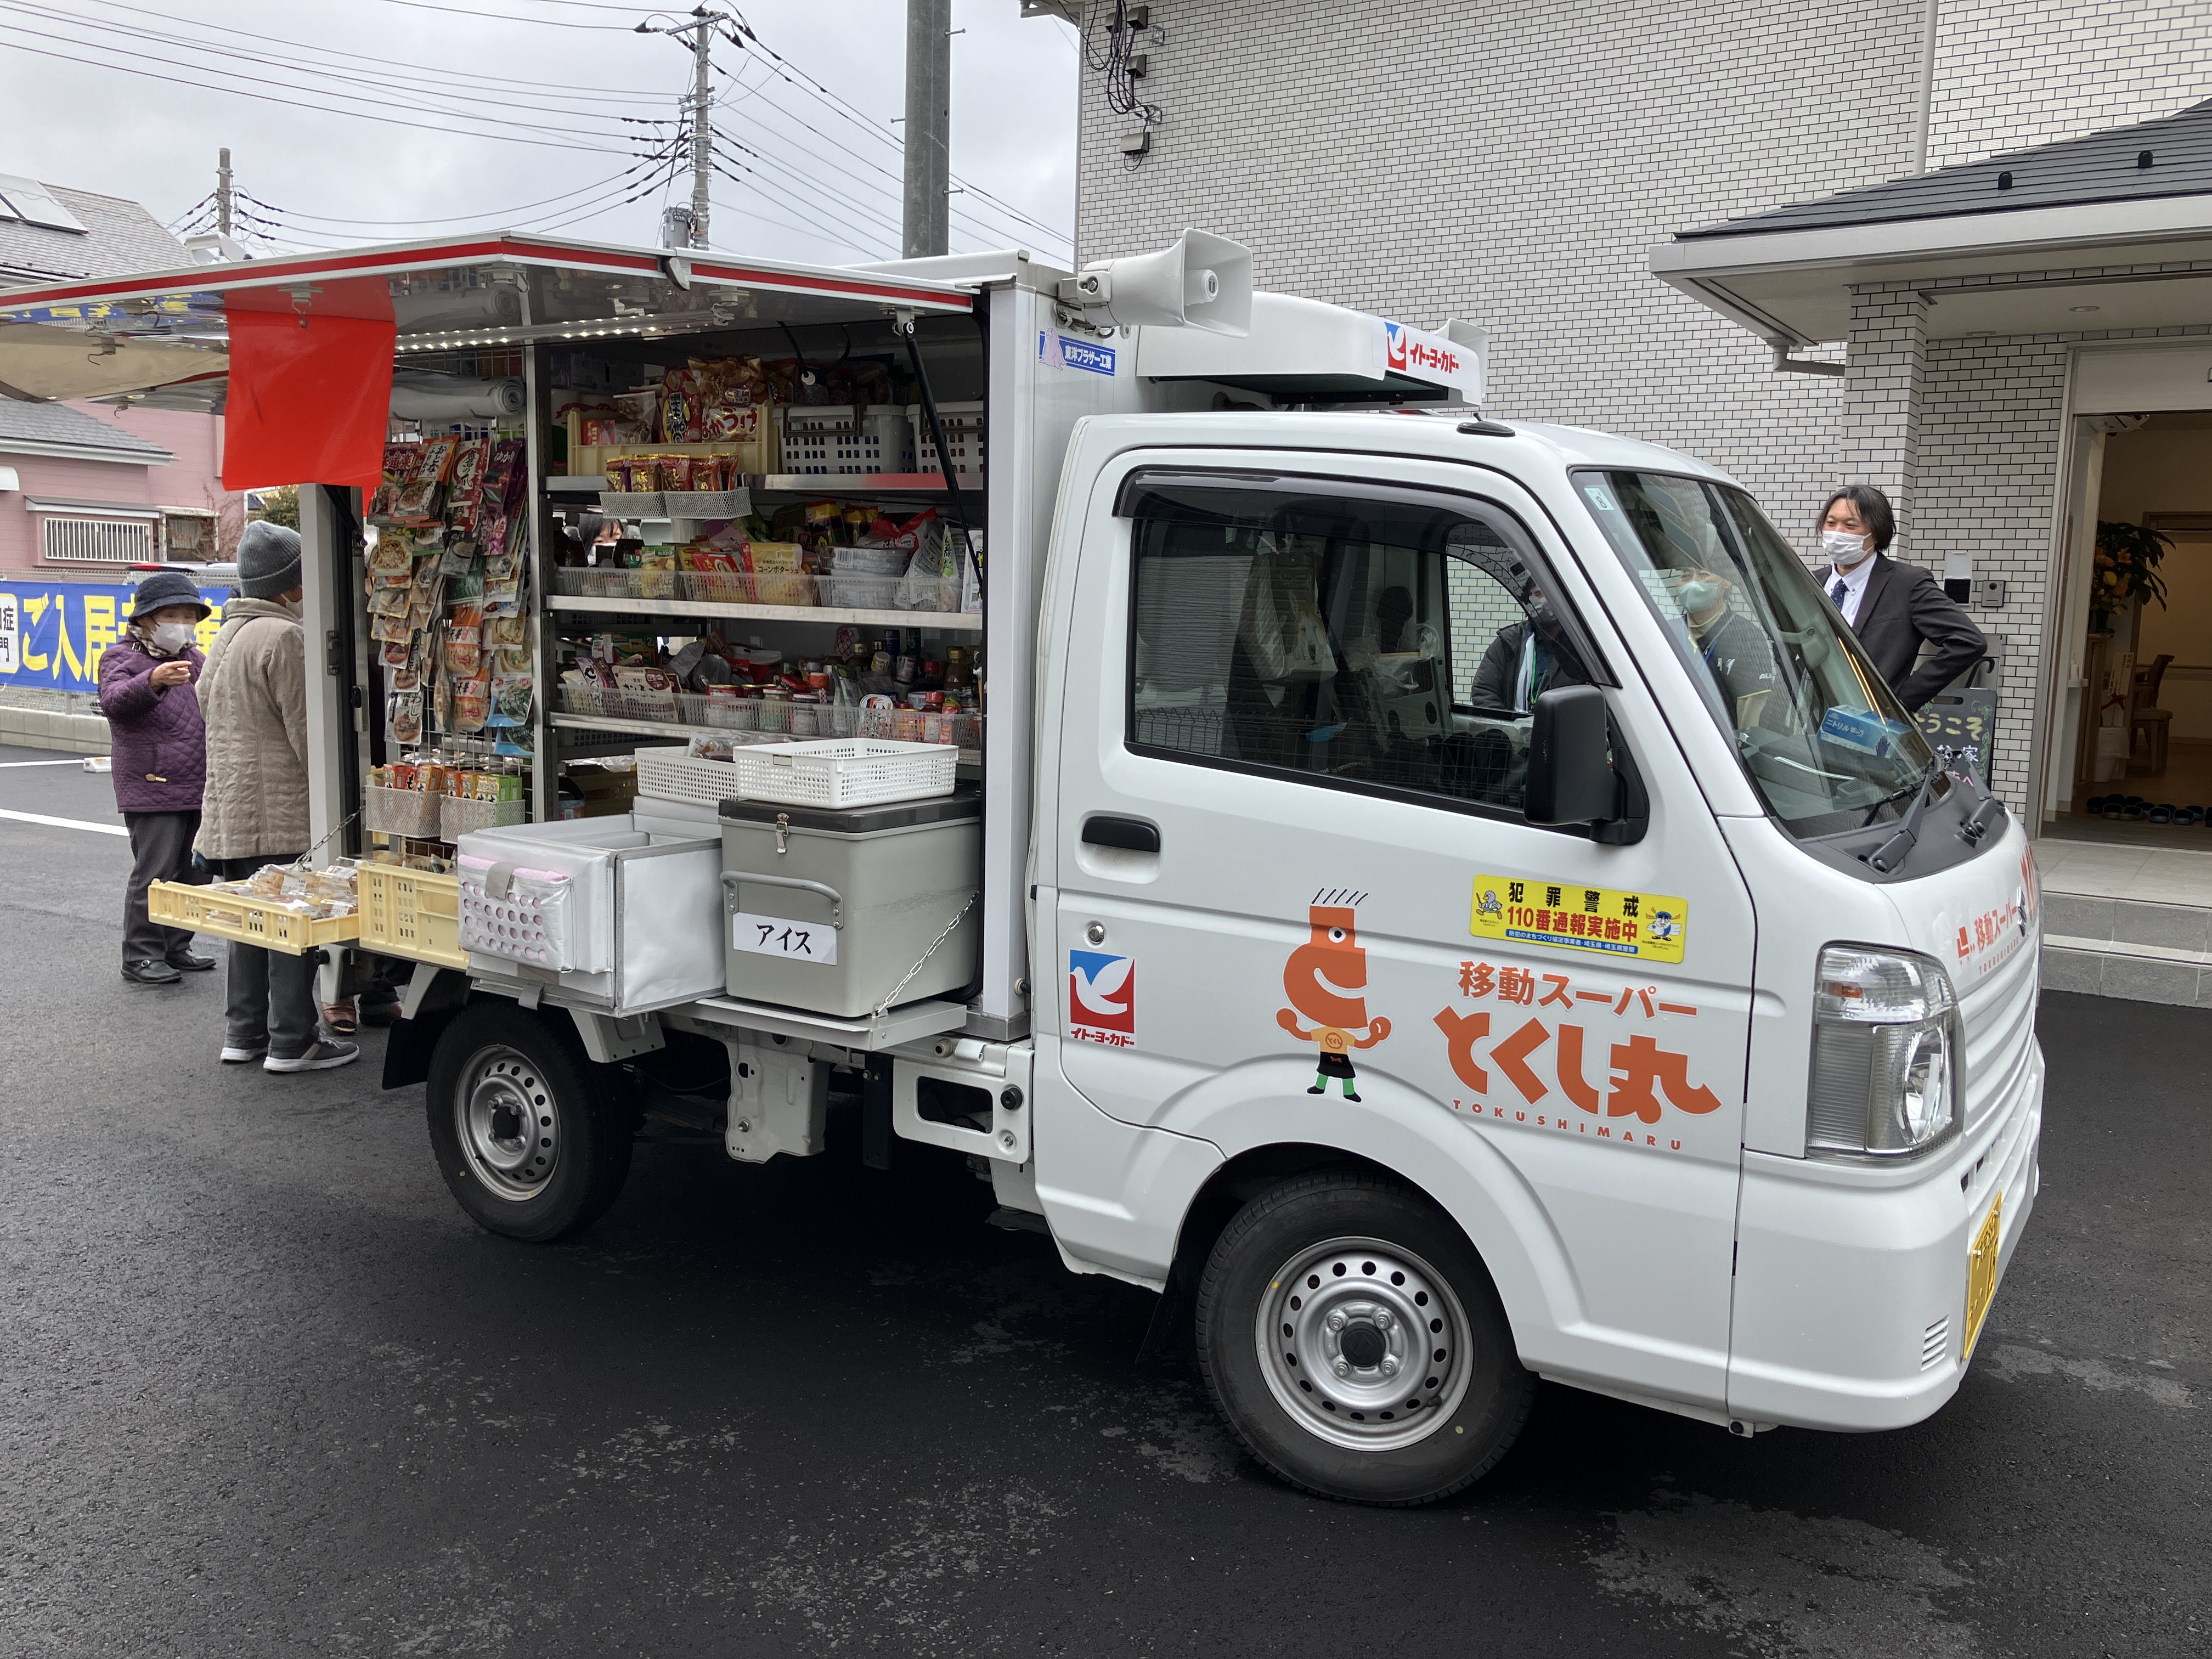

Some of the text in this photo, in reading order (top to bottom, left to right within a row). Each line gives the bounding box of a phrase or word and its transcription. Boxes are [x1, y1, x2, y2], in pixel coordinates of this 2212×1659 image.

[1410, 343, 1459, 374] イトーヨーカドー
[1596, 496, 1607, 509] 8
[1508, 882, 1639, 917] 犯罪警戒
[756, 923, 811, 954] アイス
[1507, 906, 1638, 943] 110番通報実施中
[1457, 960, 1697, 1019] 移動スーパー
[1071, 1028, 1135, 1047] イトーヨーカドー
[1432, 1005, 1723, 1125] とくし丸
[1453, 1099, 1681, 1151] TOKUSHIMARU
